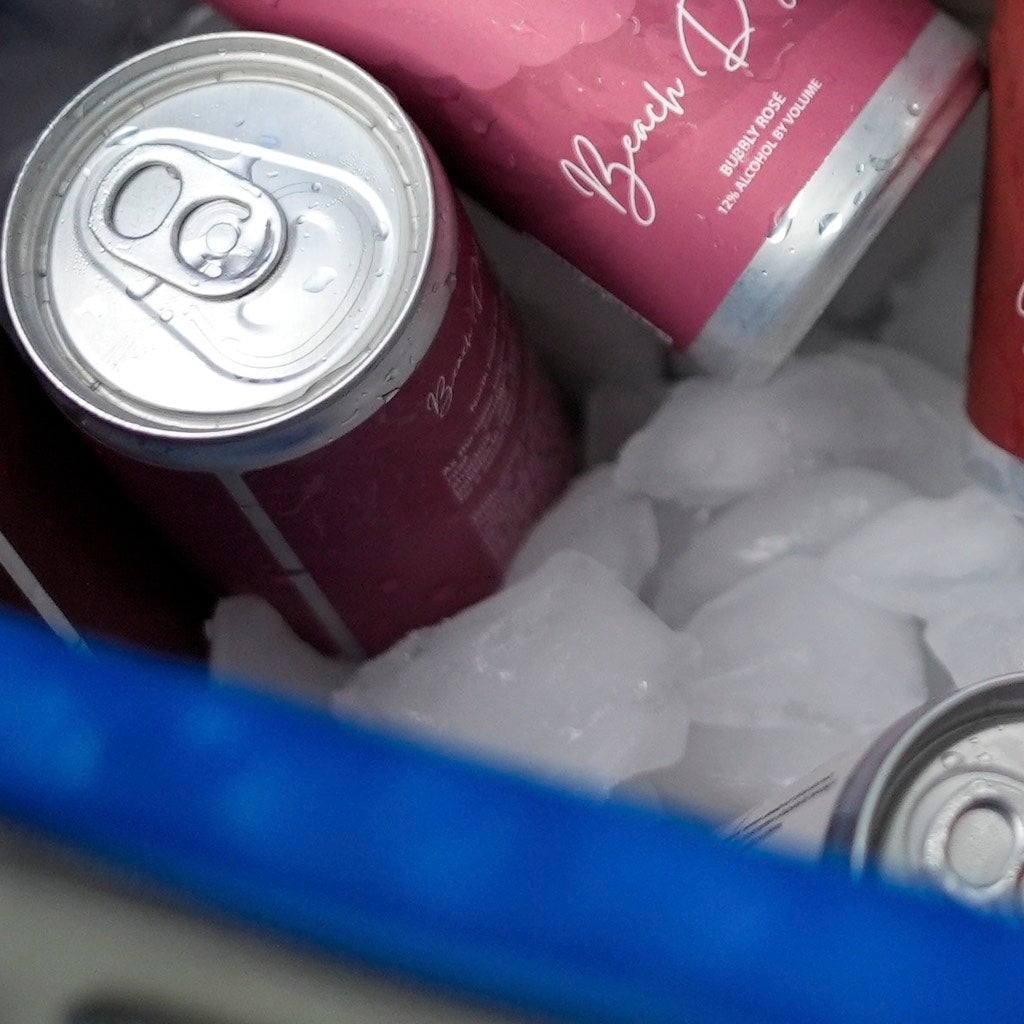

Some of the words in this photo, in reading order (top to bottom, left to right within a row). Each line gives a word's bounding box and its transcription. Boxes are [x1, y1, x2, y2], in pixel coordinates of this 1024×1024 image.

[559, 77, 686, 226] Beach
[718, 190, 741, 214] 12%
[735, 140, 778, 192] ALCOHOL
[772, 121, 788, 141] BY
[782, 77, 822, 125] VOLUME
[720, 125, 760, 177] BUBBLY
